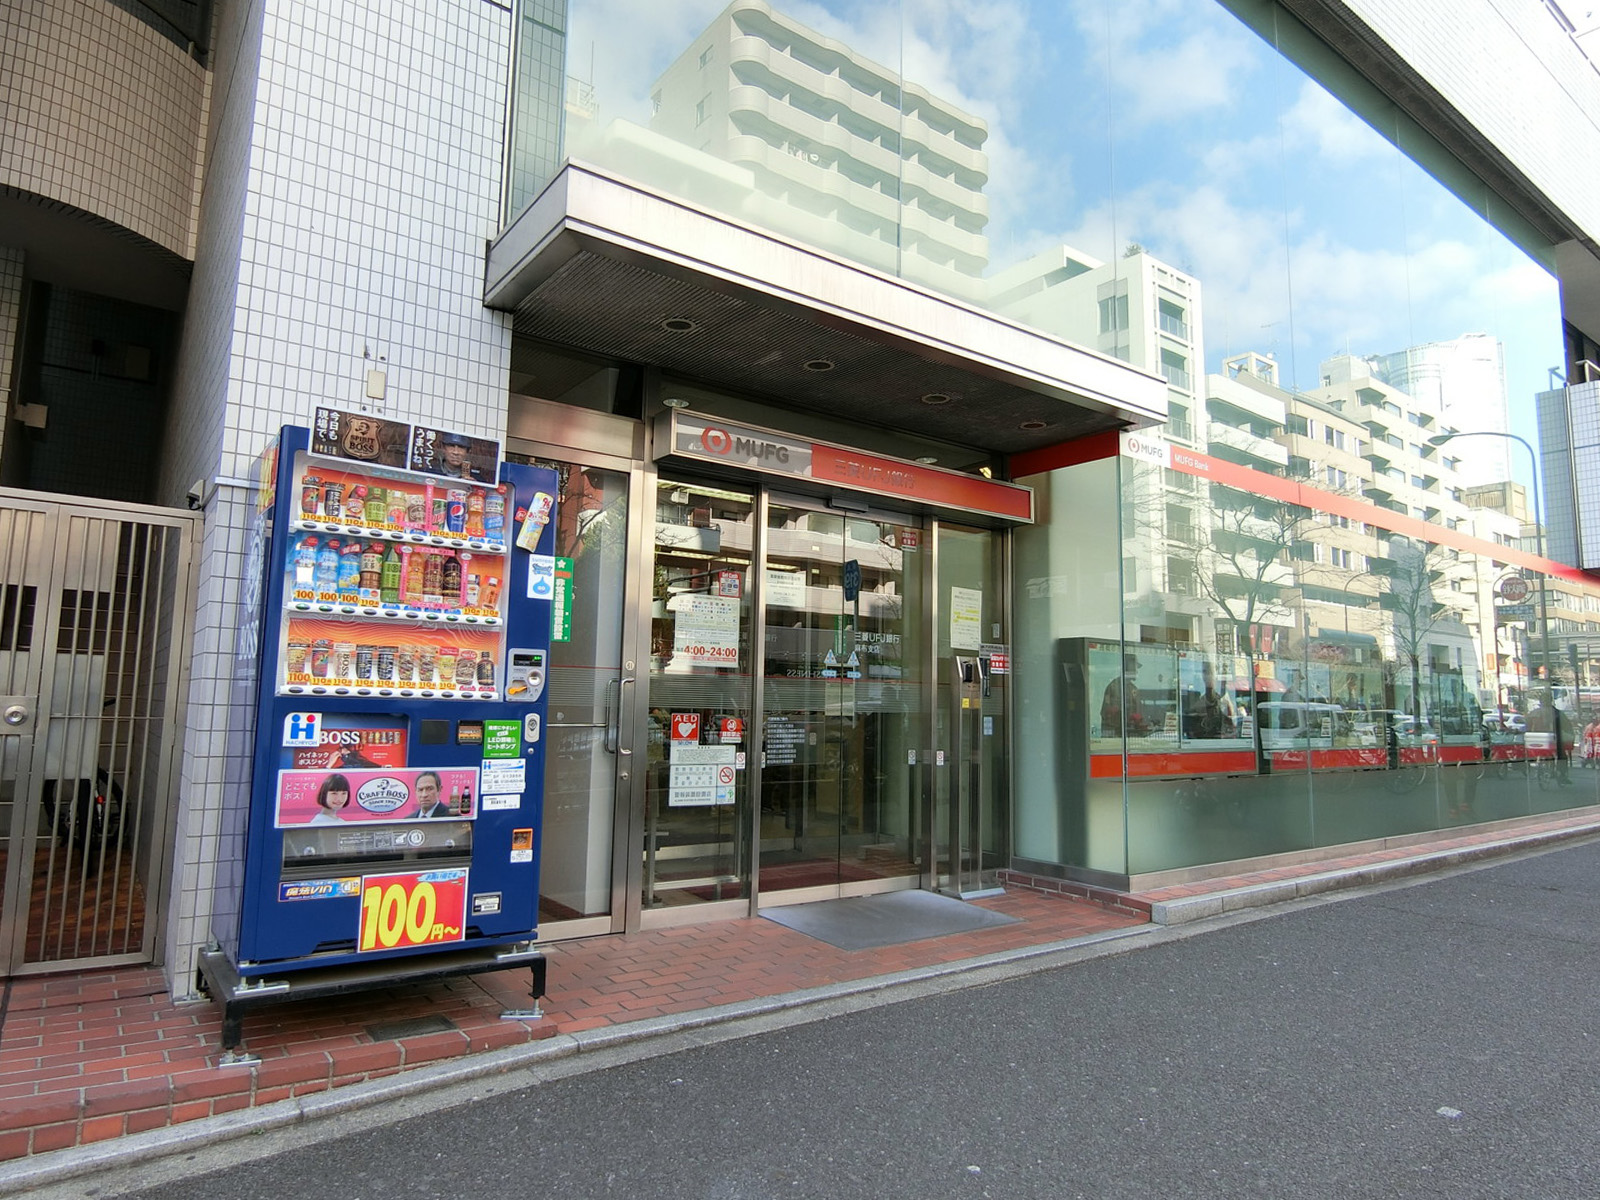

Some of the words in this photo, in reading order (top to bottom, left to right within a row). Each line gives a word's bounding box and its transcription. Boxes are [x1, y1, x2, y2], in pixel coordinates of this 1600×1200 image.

[330, 411, 340, 440] 今日も
[351, 435, 375, 444] SPIRIT
[349, 442, 374, 453] BOSS
[413, 429, 425, 468] うまいね。
[735, 436, 789, 464] MUFG
[1141, 444, 1163, 458] MUFG
[1174, 453, 1194, 467] MUFG
[1194, 458, 1209, 471] Bank
[296, 590, 314, 599] 100
[319, 592, 338, 601] 100
[341, 594, 359, 603] 100
[854, 632, 902, 644] 三菱UFJ銀行
[341, 653, 350, 678] BOSS
[674, 714, 698, 722] AED
[320, 731, 361, 745] BOSS
[285, 782, 317, 791] どこでも
[284, 792, 304, 800] ボス!
[358, 790, 385, 800] CRAFT
[386, 789, 408, 800] BOSS
